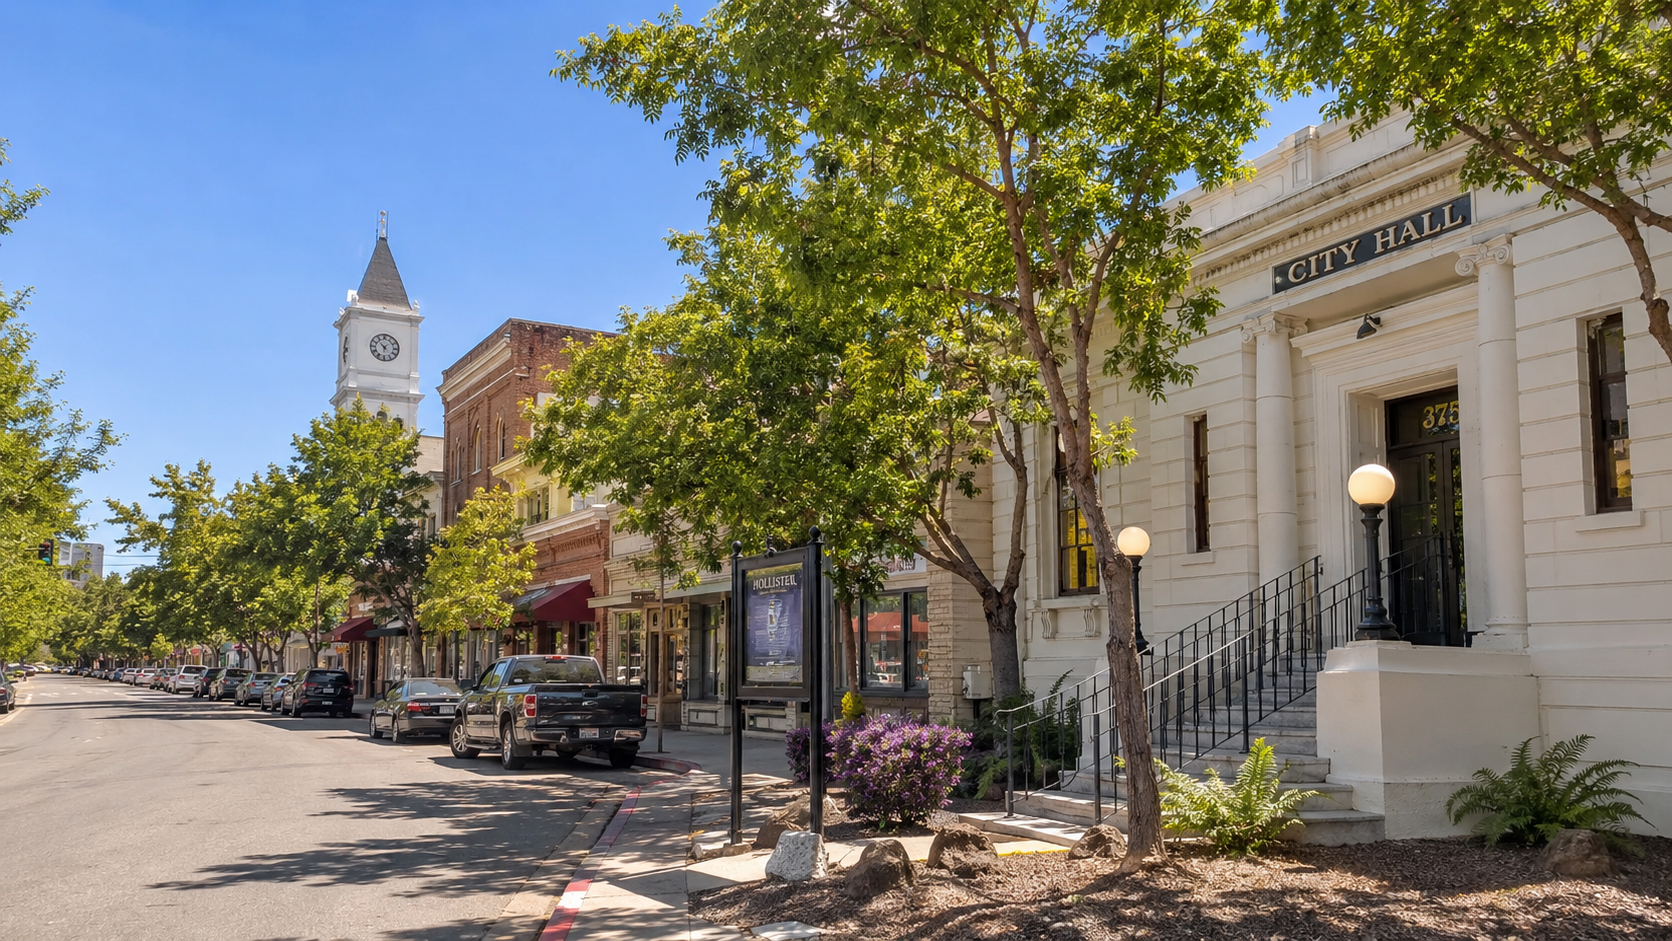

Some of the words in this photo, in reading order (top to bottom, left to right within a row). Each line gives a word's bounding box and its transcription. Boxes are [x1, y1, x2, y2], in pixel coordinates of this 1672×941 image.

[1288, 239, 1360, 283] CITY
[1374, 204, 1463, 254] HALL
[1423, 401, 1459, 428] 375
